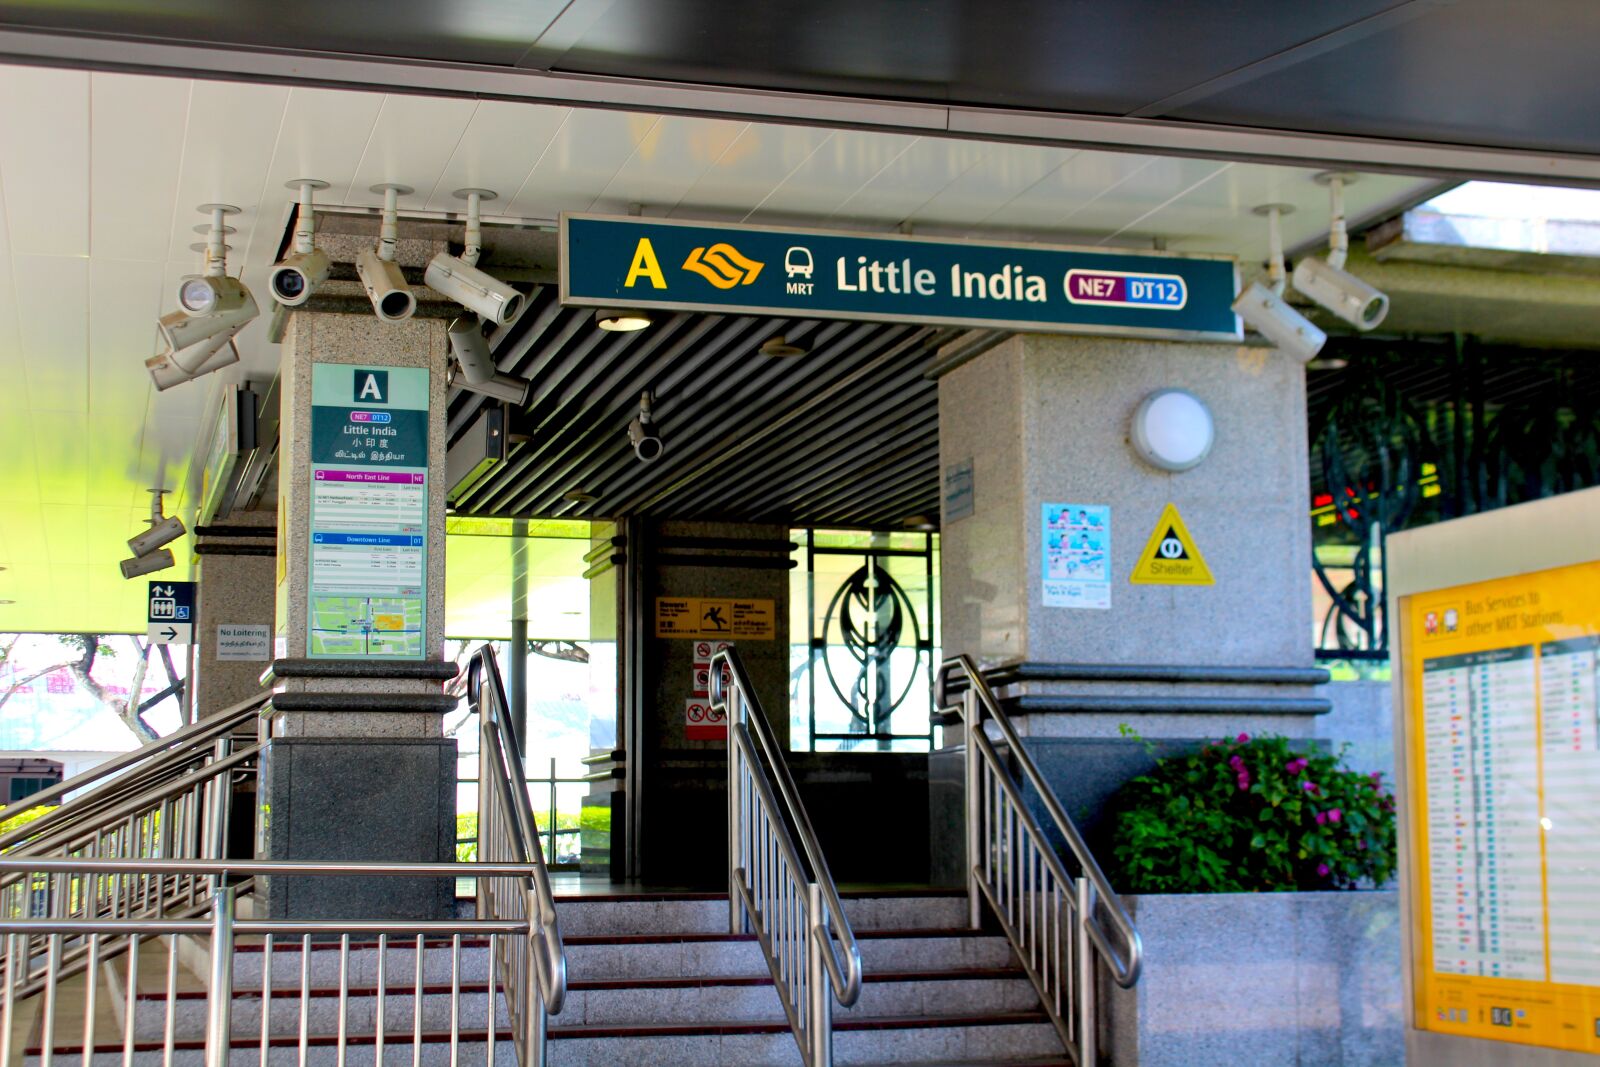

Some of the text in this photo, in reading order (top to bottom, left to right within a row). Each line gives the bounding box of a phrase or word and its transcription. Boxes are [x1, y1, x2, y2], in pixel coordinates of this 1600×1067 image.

[623, 237, 668, 290] A
[836, 255, 1048, 303] Little India
[786, 282, 815, 296] MRT
[1078, 277, 1179, 301] NE7 DT12
[360, 373, 382, 400] A
[372, 413, 389, 421] DT12
[343, 425, 397, 436] Little India
[352, 438, 388, 448] 小印度
[364, 473, 377, 481] East
[1150, 562, 1194, 576] Shelter
[1465, 592, 1540, 615] Bus Services to
[1466, 610, 1564, 637] other MRT Stations
[233, 629, 267, 638] Loitering
